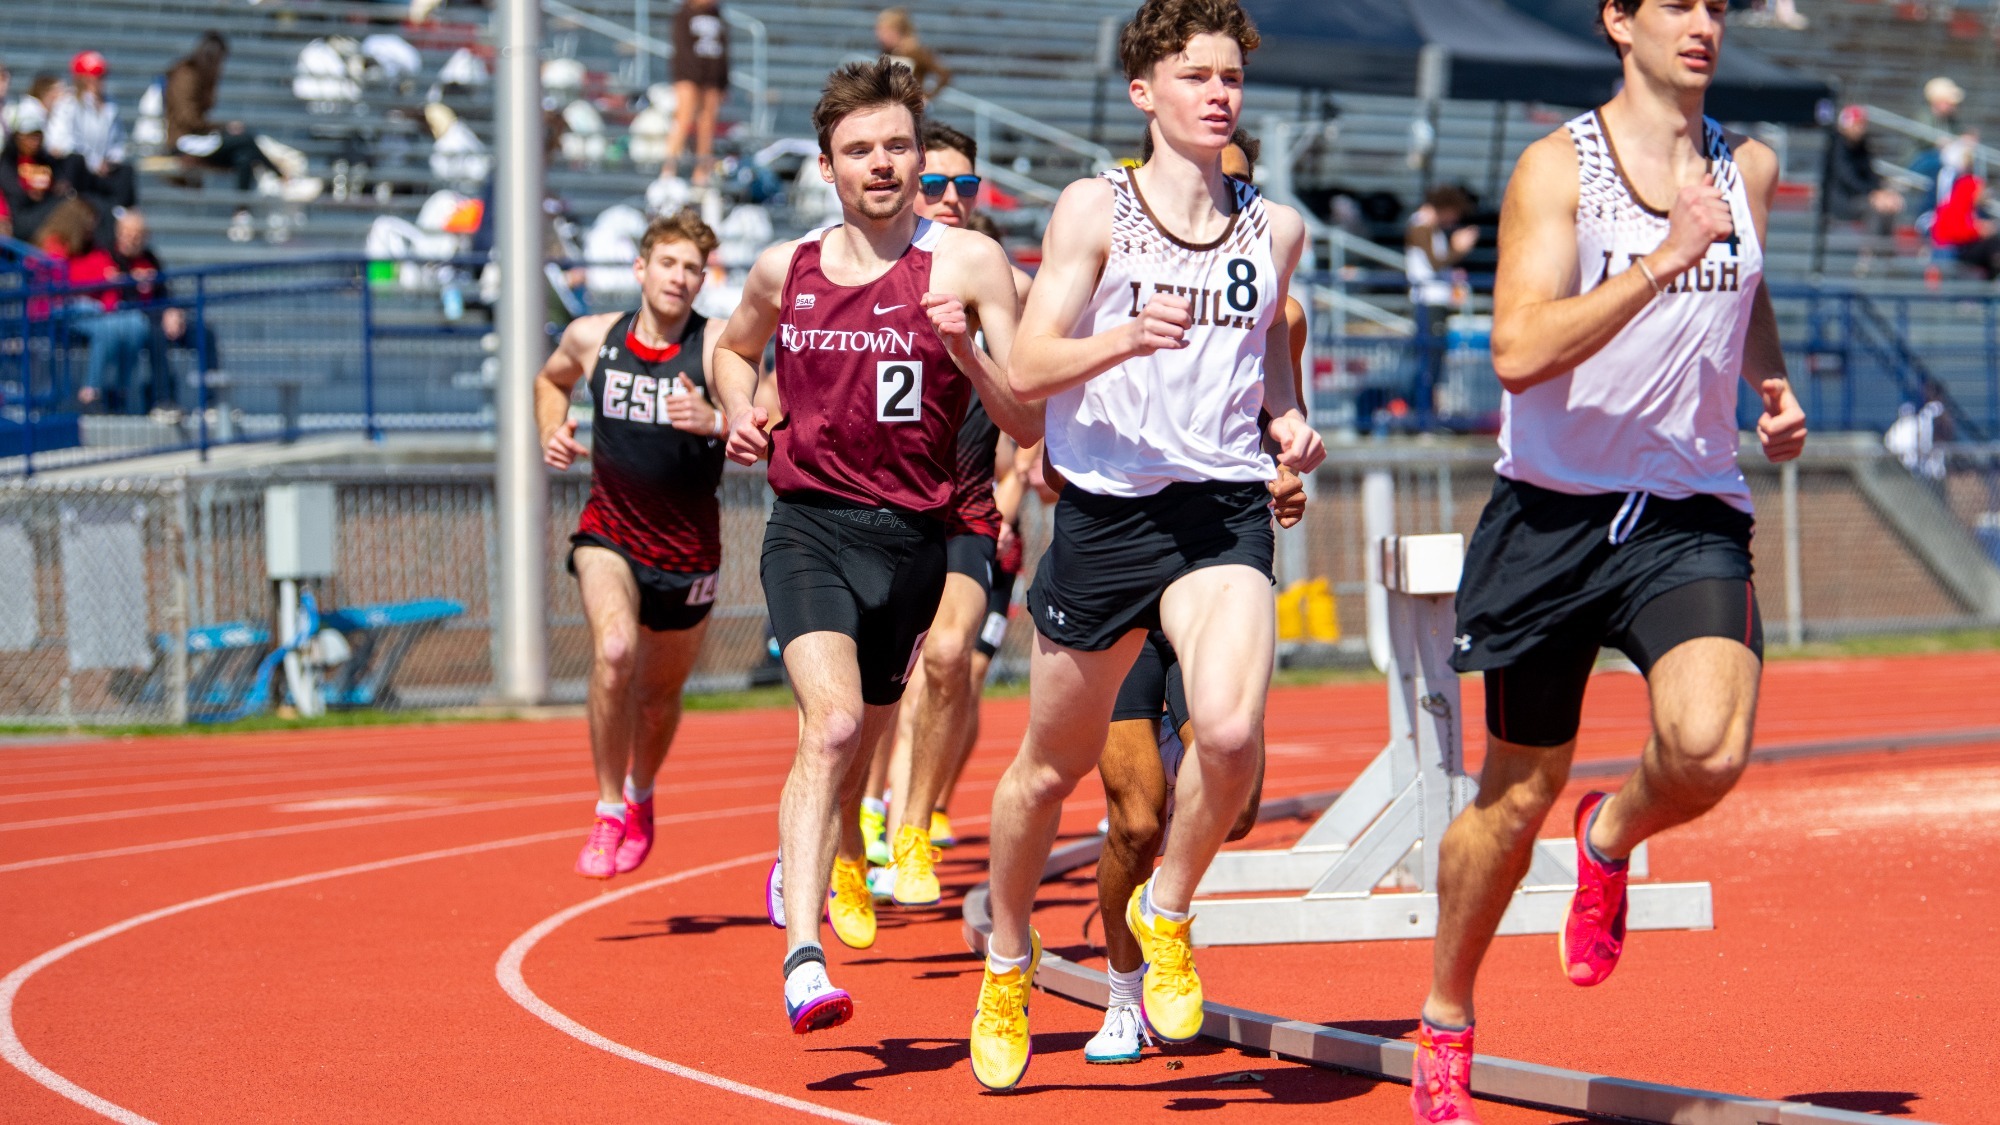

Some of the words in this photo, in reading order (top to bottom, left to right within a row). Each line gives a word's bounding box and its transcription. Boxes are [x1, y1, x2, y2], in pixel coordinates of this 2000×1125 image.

[1226, 258, 1259, 312] 8
[780, 323, 919, 356] KUTZTOWN
[882, 365, 915, 417] 2
